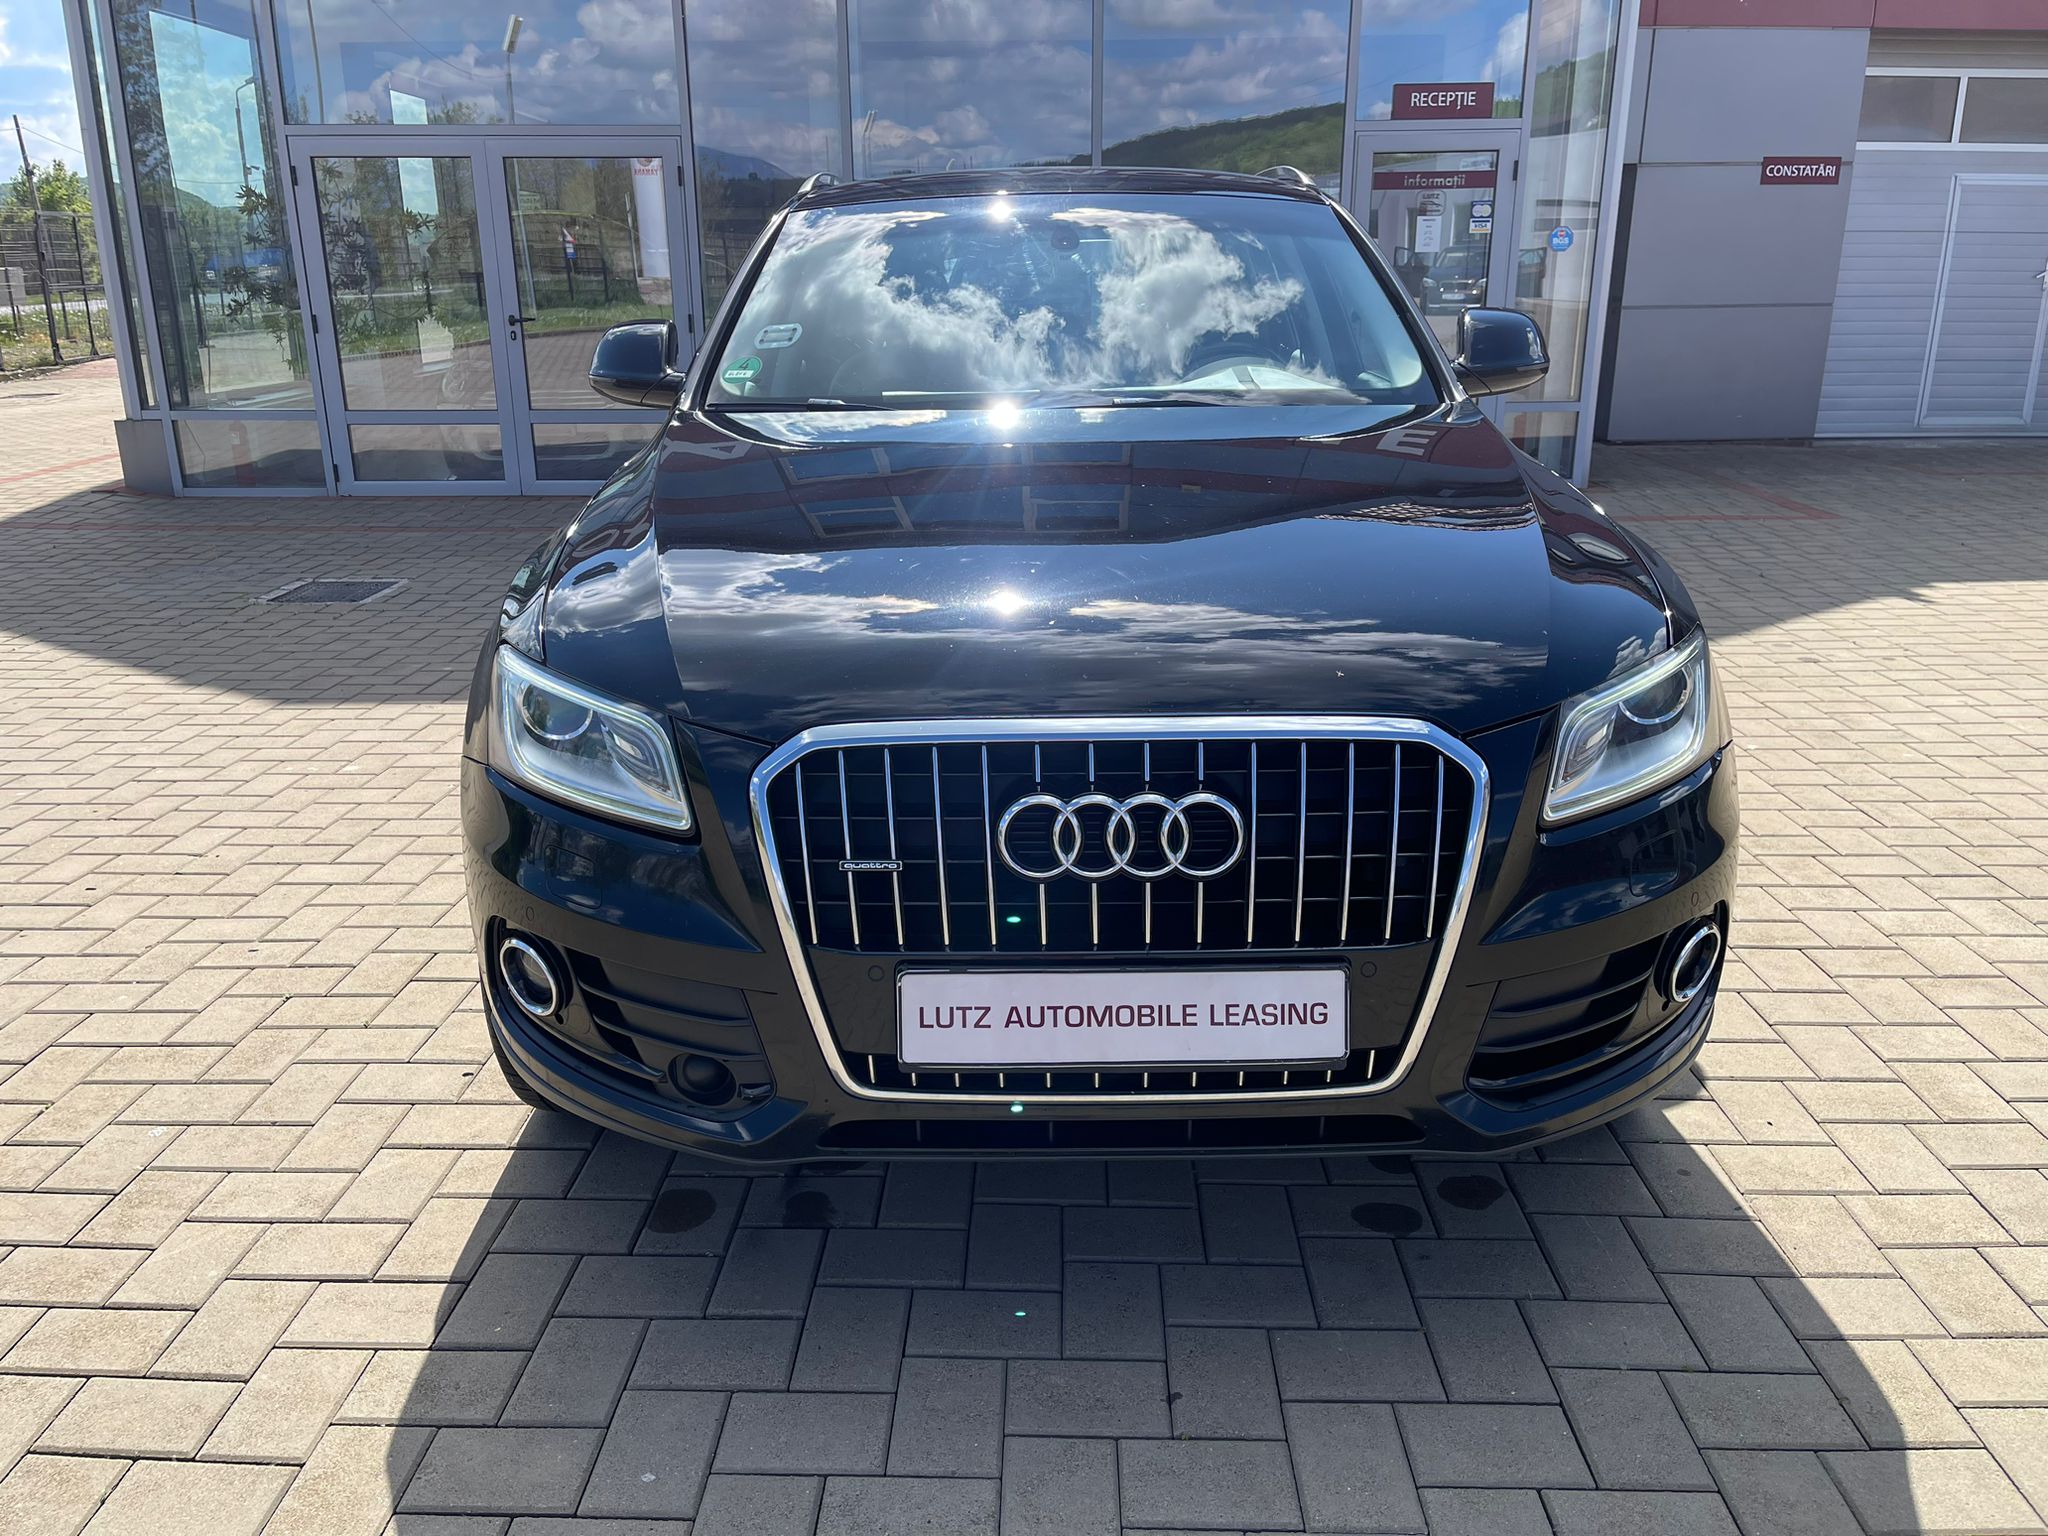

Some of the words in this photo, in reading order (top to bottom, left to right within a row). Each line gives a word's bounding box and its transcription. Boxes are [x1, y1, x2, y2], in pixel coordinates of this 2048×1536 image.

[1766, 163, 1836, 177] CONSTATĂRI
[738, 358, 751, 371] 4
[918, 1006, 992, 1029] LUTZ
[1004, 1004, 1198, 1029] AUTOMOBILE
[1209, 1002, 1329, 1027] LEASING
